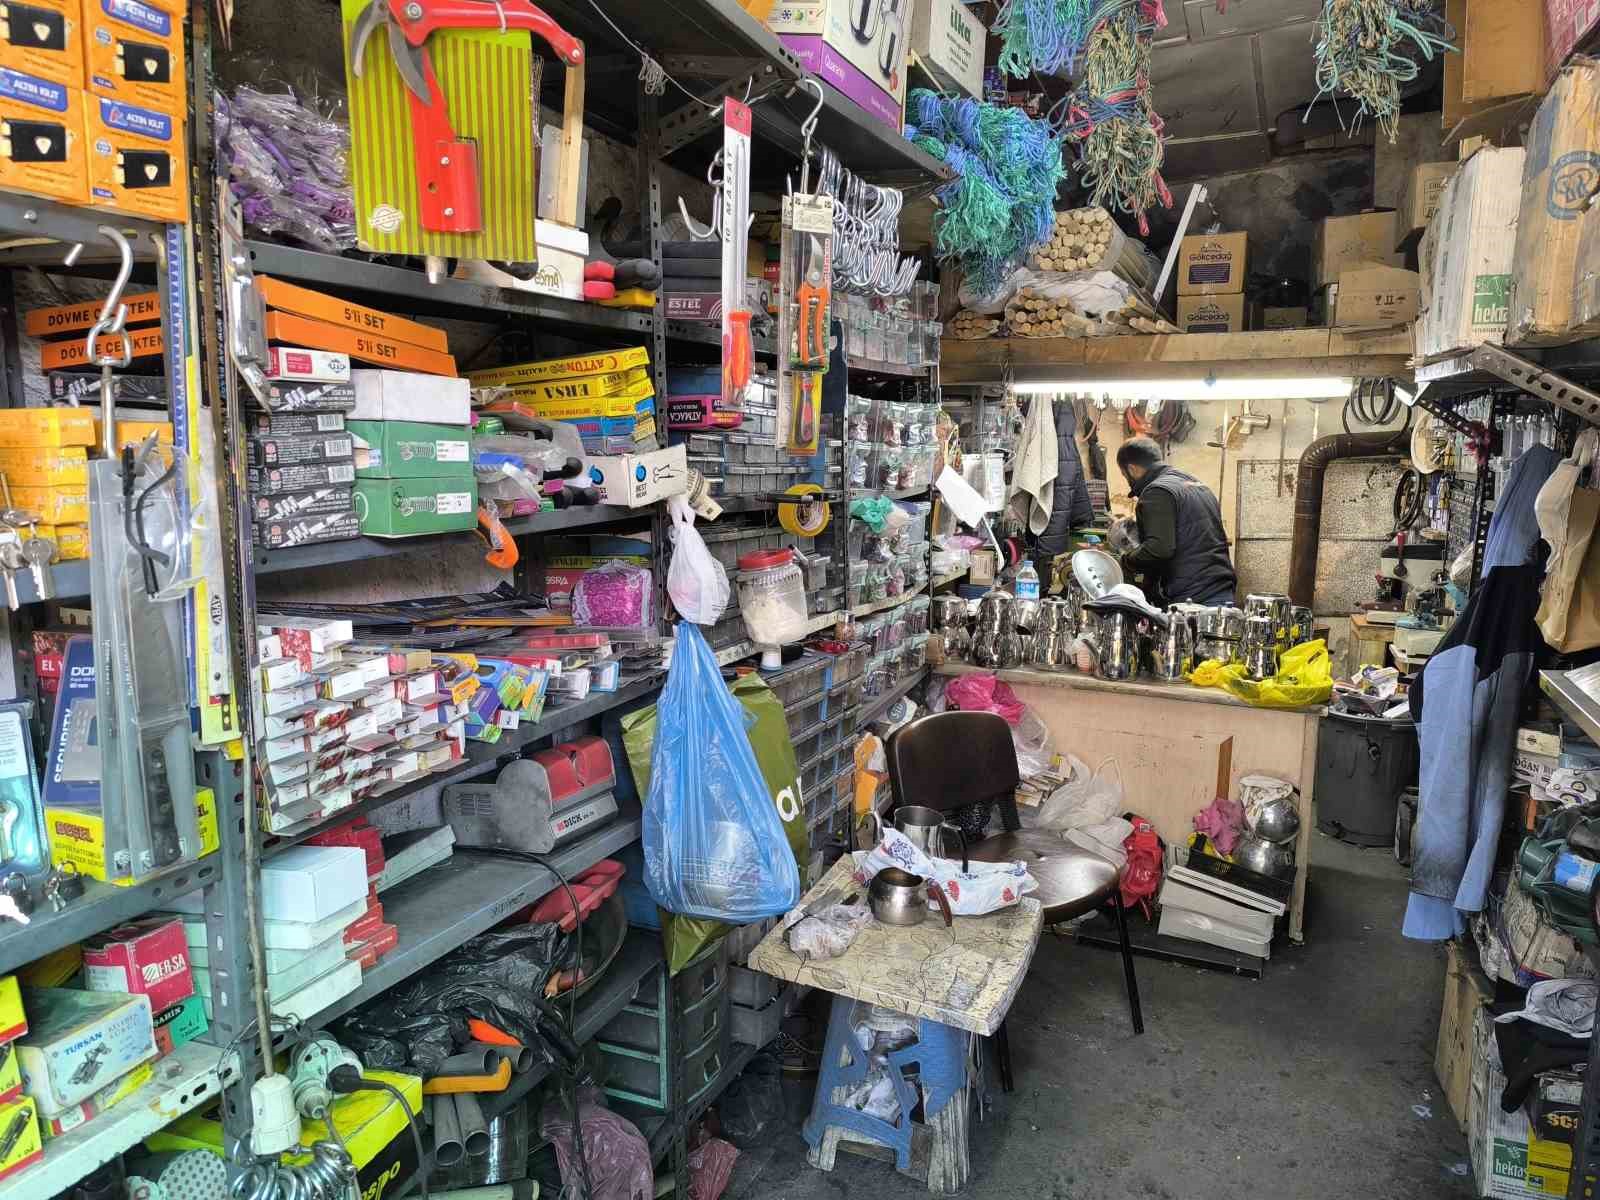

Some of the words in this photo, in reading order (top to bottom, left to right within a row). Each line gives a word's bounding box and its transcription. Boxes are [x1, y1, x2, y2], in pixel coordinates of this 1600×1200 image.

[365, 312, 385, 329] SET
[377, 343, 397, 359] SET
[543, 383, 590, 400] ERSA
[41, 659, 55, 672] EL
[1513, 756, 1539, 773] OĞAN
